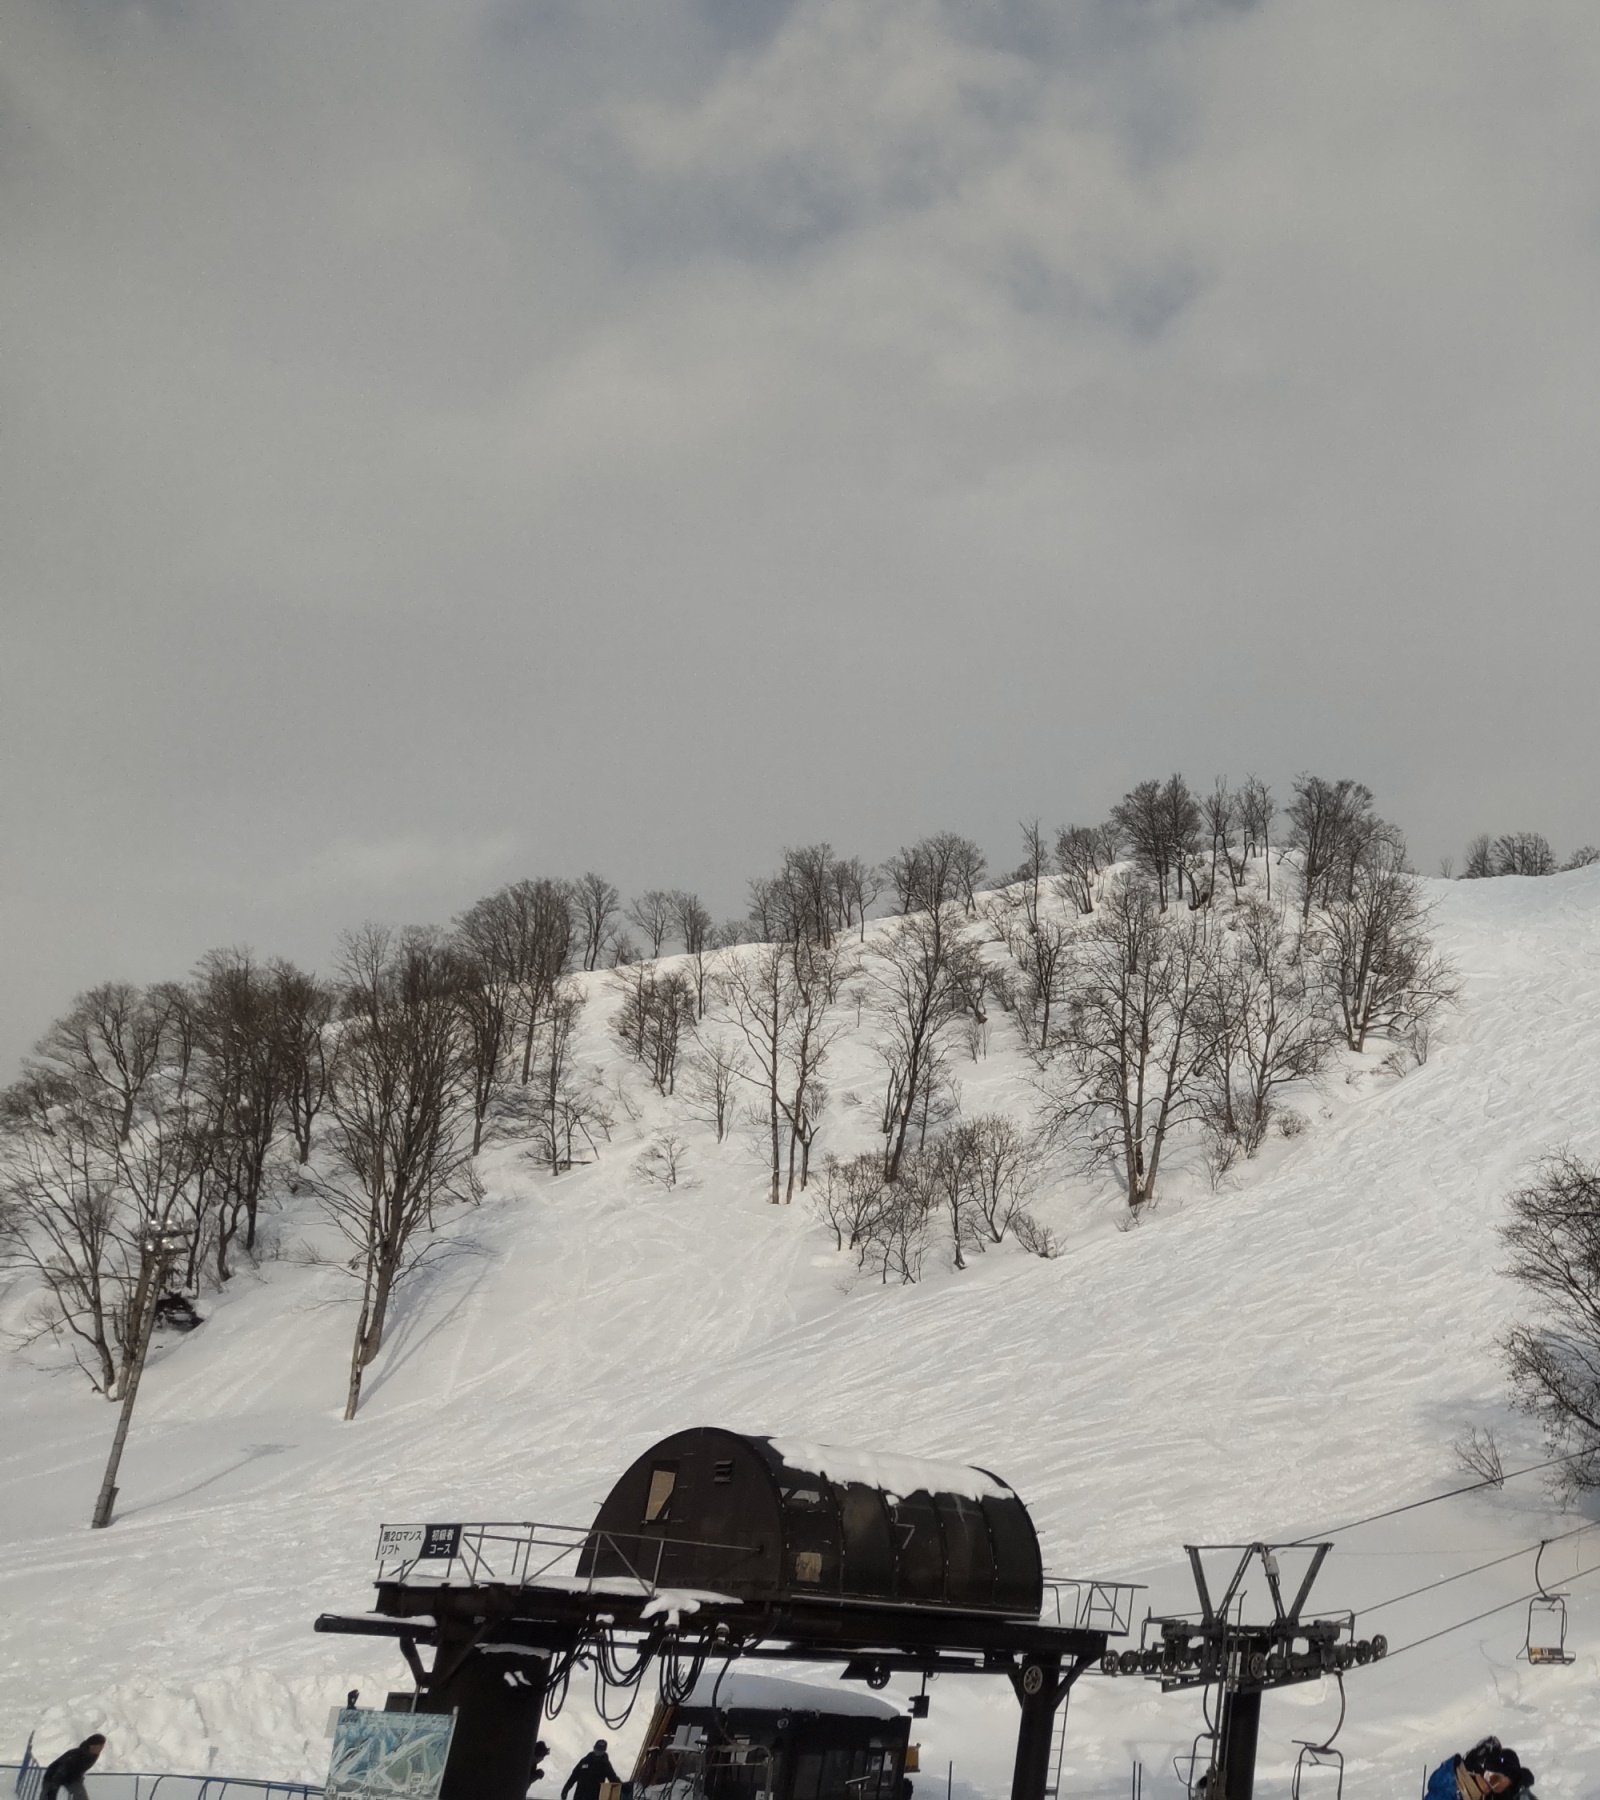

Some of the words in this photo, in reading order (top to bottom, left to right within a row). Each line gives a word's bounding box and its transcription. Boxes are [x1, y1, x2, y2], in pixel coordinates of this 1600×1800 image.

[431, 1528, 455, 1542] 初級者
[382, 1544, 400, 1555] リフト
[429, 1544, 451, 1554] コース
